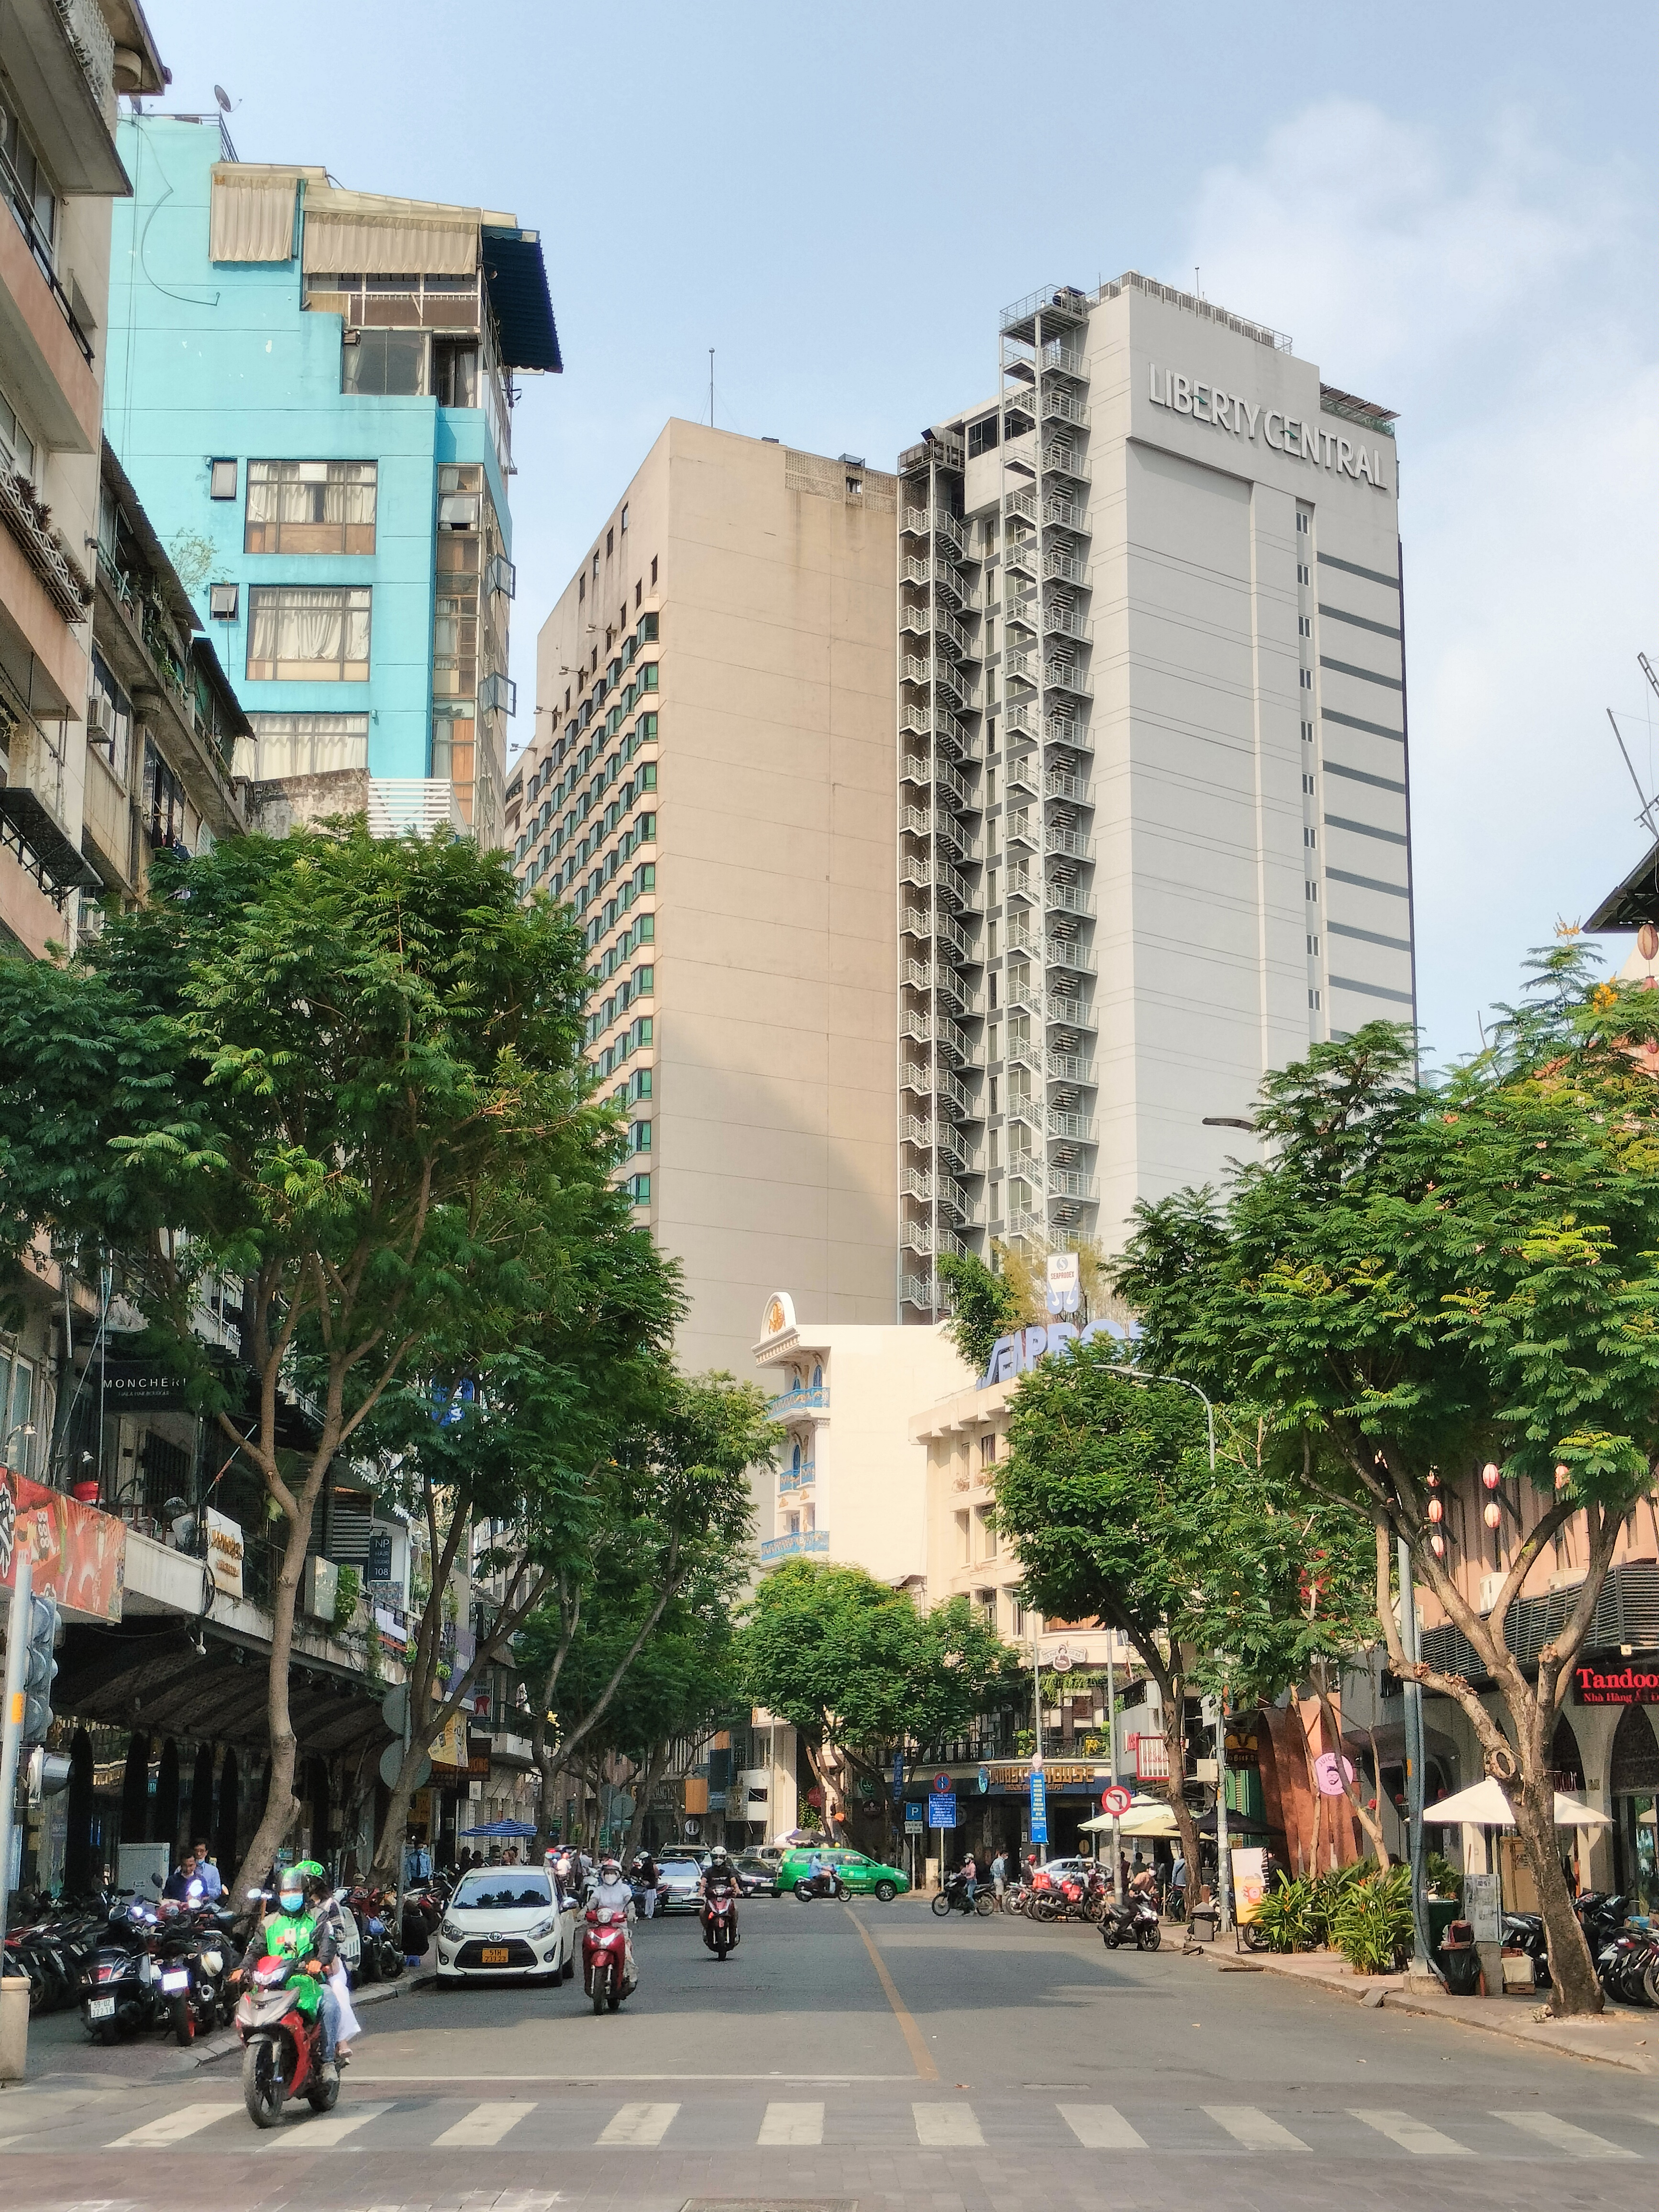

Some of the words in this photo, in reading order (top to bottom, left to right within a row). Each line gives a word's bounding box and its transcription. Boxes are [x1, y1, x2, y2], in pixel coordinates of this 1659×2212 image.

[1149, 363, 1261, 439] LIBERTY
[1264, 409, 1387, 490] CENTRAL
[1051, 1271, 1074, 1280] SEAPRODEX
[375, 1538, 390, 1548] NP
[1576, 1668, 1659, 1689] Tandoo
[1584, 1693, 1604, 1702] Nhà
[1606, 1692, 1632, 1703] Hàng
[1044, 1765, 1095, 1784] HOUSE
[911, 1807, 919, 1816] P
[92, 2007, 113, 2018] 322.16
